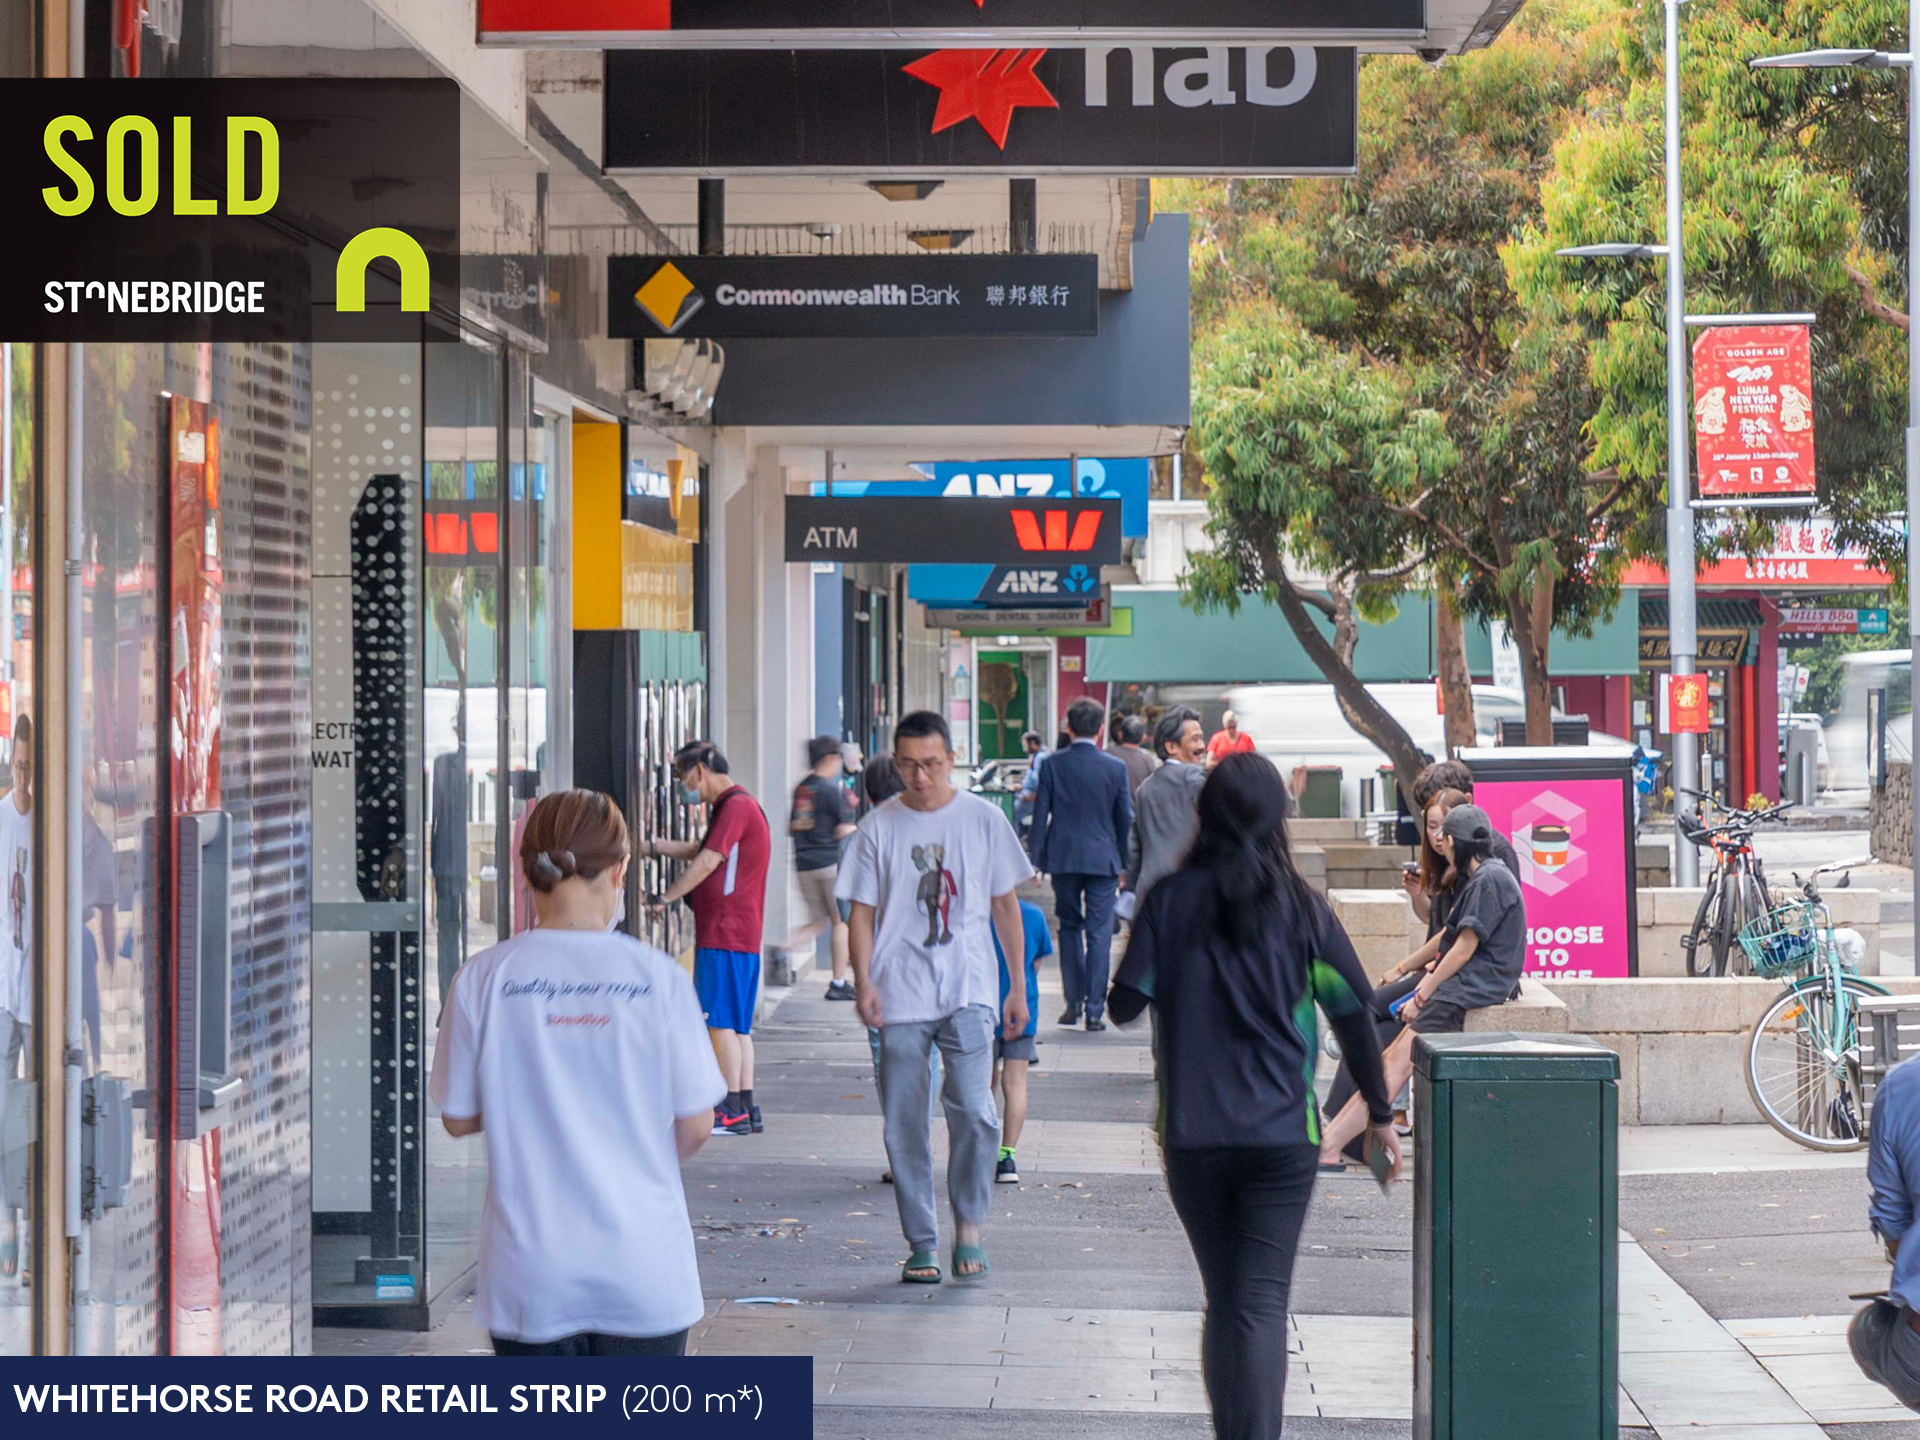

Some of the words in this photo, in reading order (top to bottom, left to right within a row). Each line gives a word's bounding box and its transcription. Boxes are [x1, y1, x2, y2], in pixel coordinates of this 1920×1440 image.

[1085, 46, 1317, 107] nab
[715, 284, 908, 306] Commonwealth
[910, 284, 961, 306] Bank
[985, 285, 1070, 306] 聯邦銀行
[1726, 349, 1763, 357] GOLDEN
[1766, 348, 1785, 356] AGE
[1737, 386, 1769, 395] LUNAR
[1729, 395, 1752, 404] NEW
[1752, 395, 1777, 404] YEAR
[1732, 404, 1775, 413] FESTIVAL
[803, 526, 858, 549] ATM
[997, 570, 1058, 593] ANZ
[996, 612, 1030, 621] DENTAL
[1037, 612, 1080, 621] SURGERY
[1790, 611, 1824, 620] HILLS
[1829, 611, 1854, 622] BBQ
[1535, 948, 1570, 967] TO
